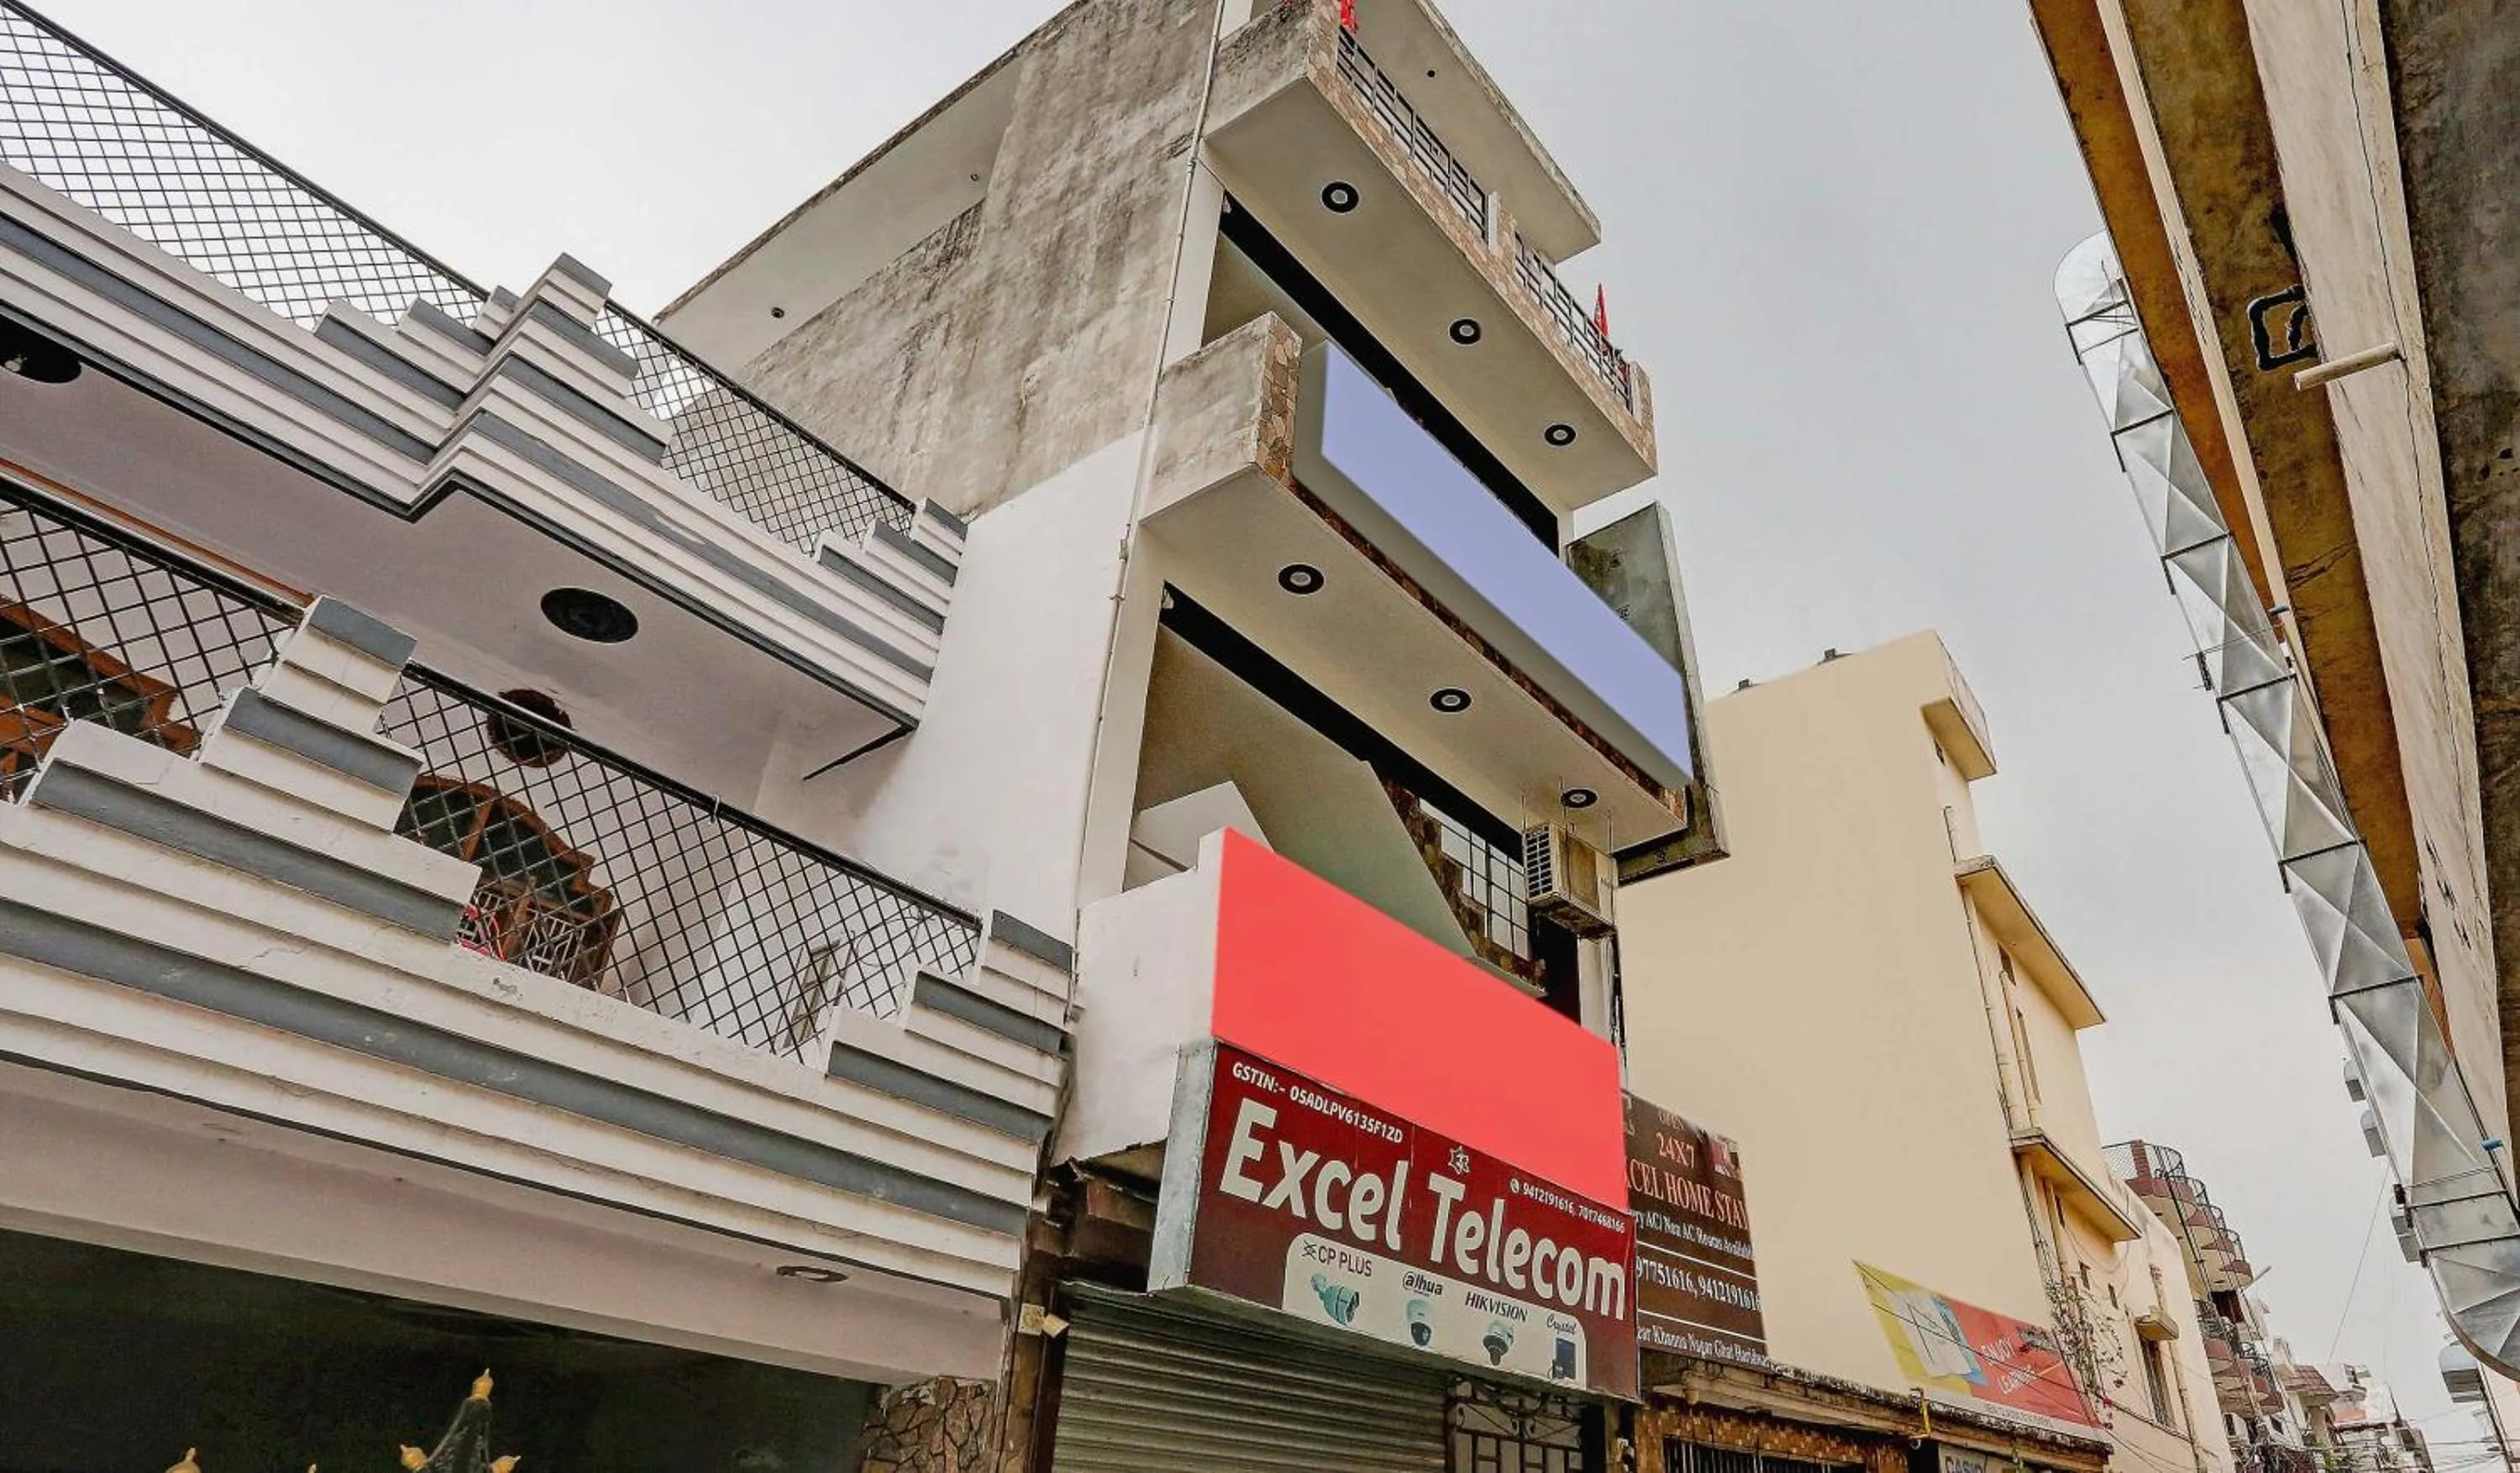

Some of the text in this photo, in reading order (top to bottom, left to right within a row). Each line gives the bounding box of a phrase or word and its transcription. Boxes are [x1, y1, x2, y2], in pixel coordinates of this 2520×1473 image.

[1656, 1131, 1694, 1169] 24X7
[1220, 1098, 1626, 1321] Excel Telecom
[1664, 1171, 1714, 1219] HOME
[1318, 1245, 1372, 1277] CP PLUS
[1465, 1291, 1527, 1323] HIKVISION
